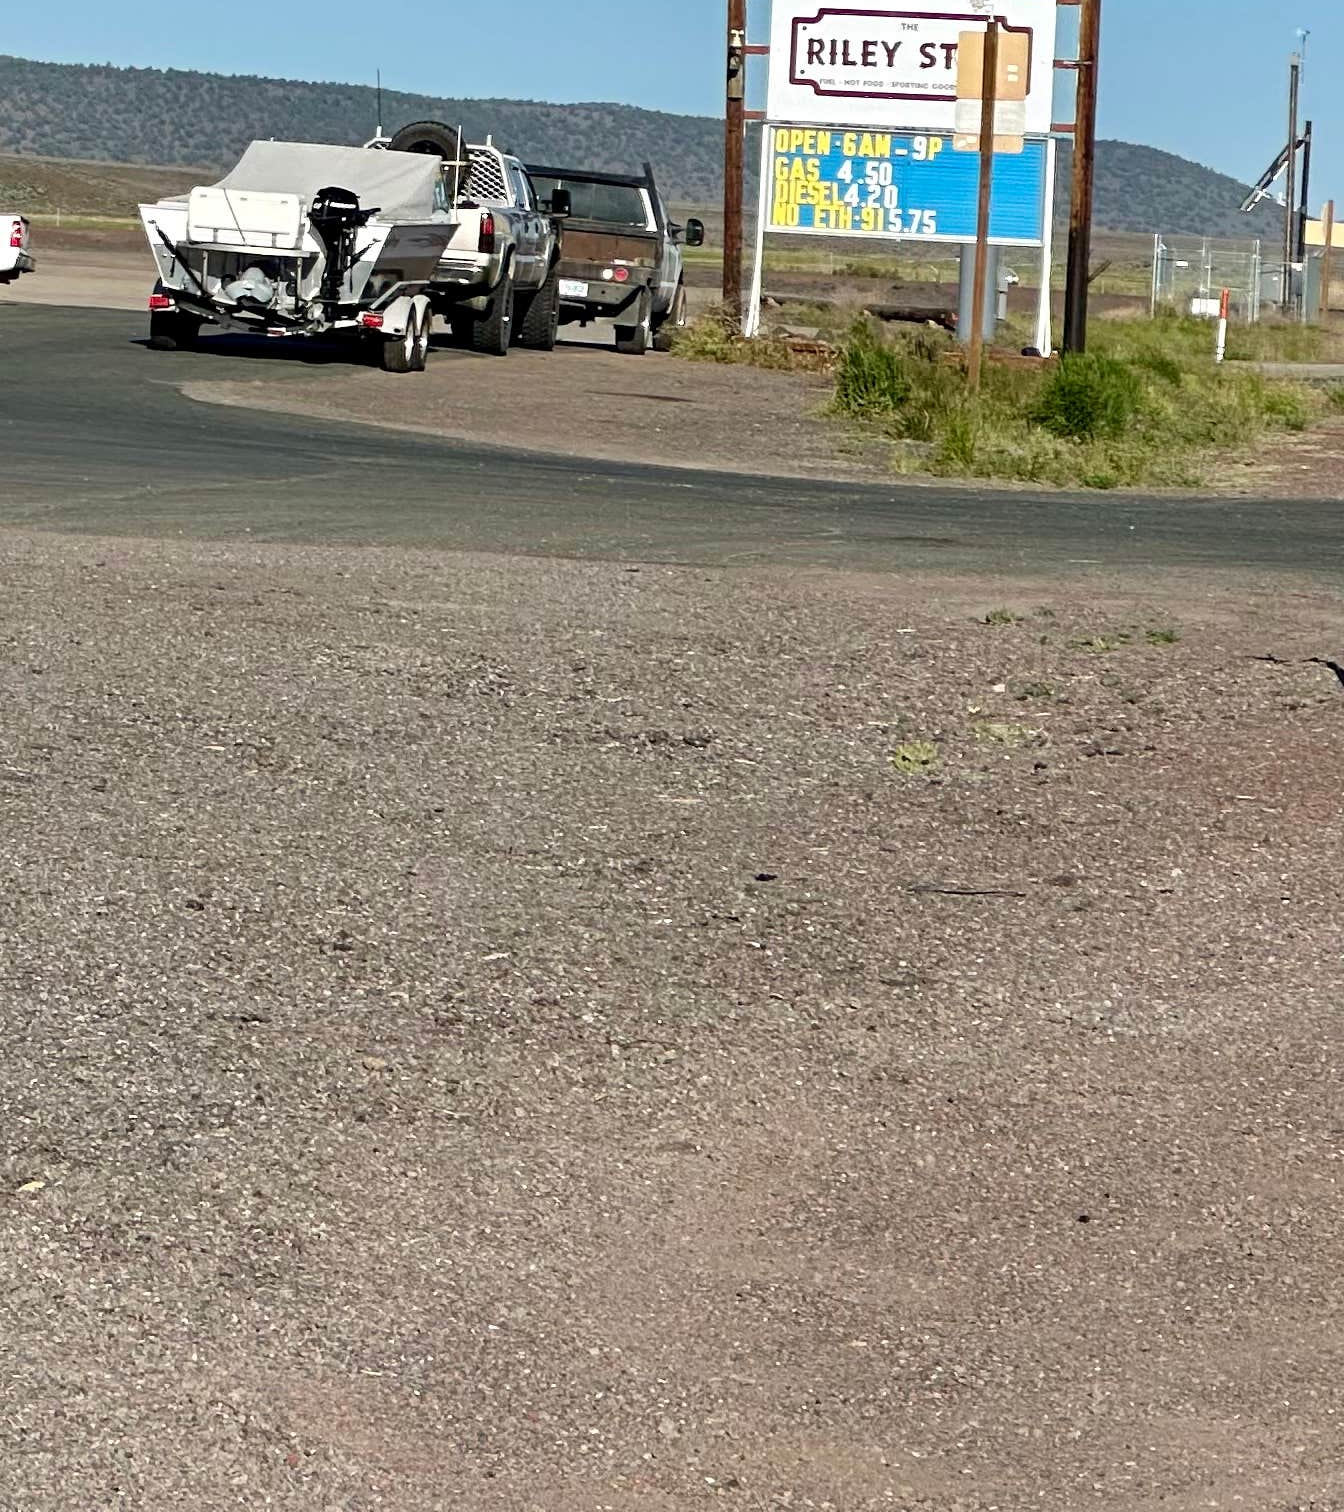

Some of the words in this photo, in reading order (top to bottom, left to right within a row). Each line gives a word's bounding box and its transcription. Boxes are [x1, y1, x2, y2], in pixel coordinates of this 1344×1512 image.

[901, 22, 919, 32] THE
[807, 38, 902, 68] RILEY
[819, 78, 836, 86] FUEL
[863, 80, 884, 88] FOOD
[932, 83, 958, 91] GOOD
[775, 128, 831, 155] OPEN
[775, 157, 820, 181] GAS
[837, 159, 893, 186] 4.50
[775, 180, 844, 206] DIESEL
[843, 183, 899, 209] 4.20
[772, 202, 800, 226] NO
[888, 209, 937, 234] 5.75
